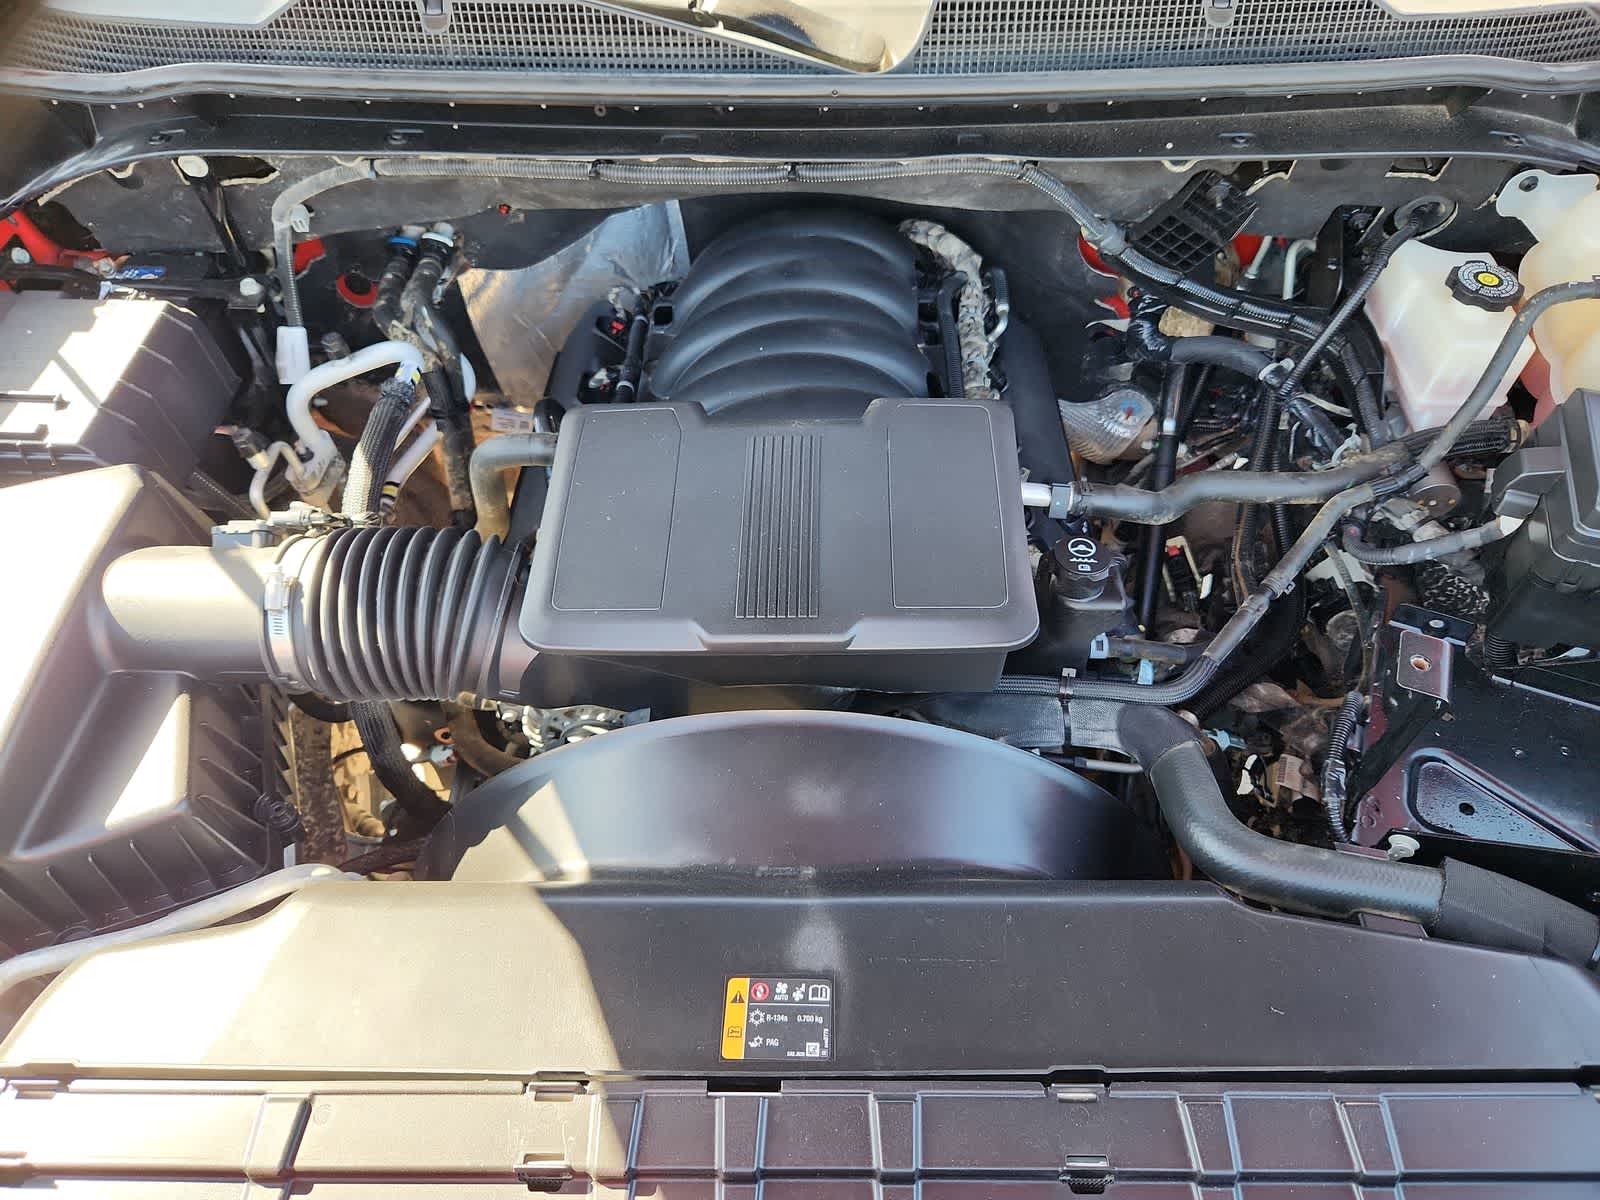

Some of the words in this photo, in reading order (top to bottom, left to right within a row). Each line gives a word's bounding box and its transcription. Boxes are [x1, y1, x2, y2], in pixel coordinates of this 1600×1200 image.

[766, 1013, 788, 1022] R-134a
[815, 1014, 823, 1024] kg
[765, 1038, 779, 1047] PAG
